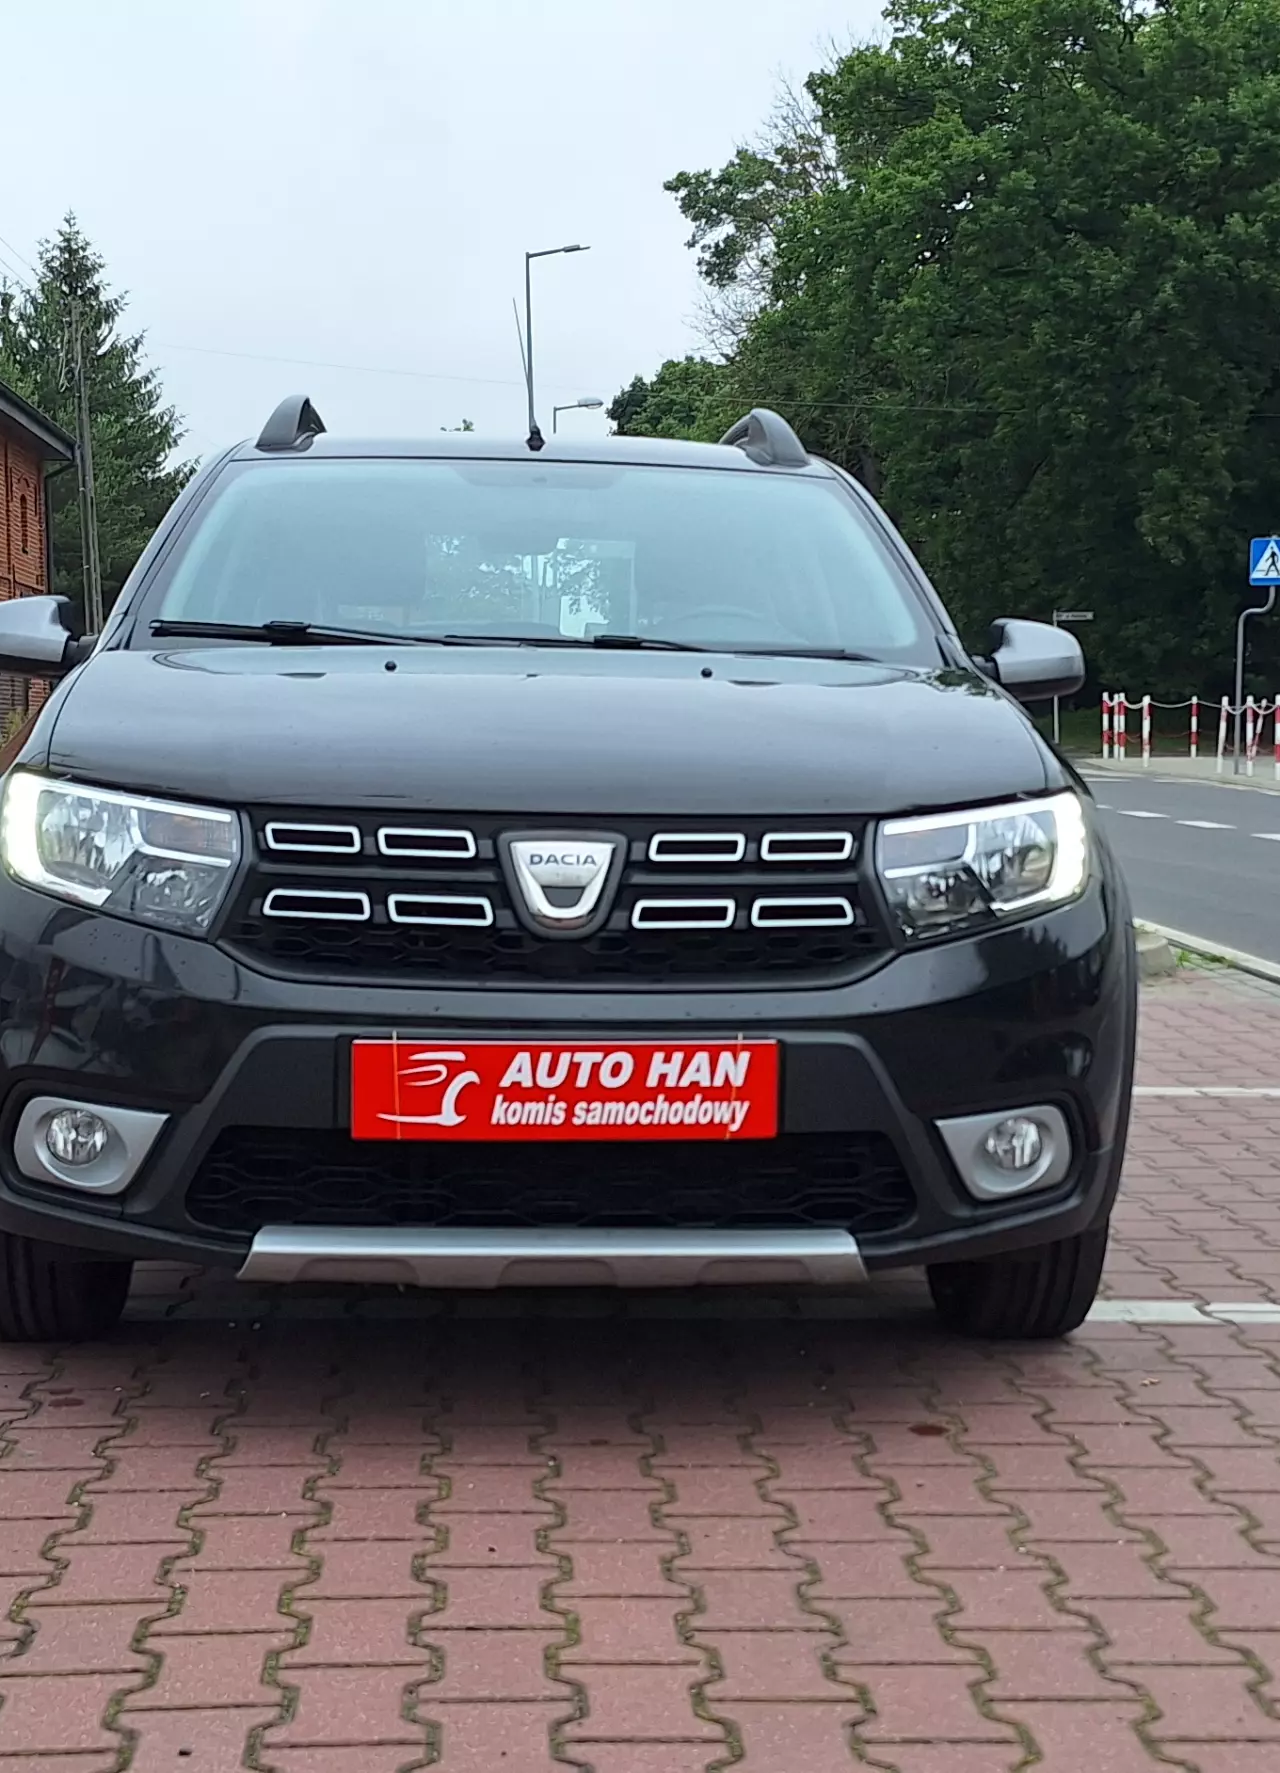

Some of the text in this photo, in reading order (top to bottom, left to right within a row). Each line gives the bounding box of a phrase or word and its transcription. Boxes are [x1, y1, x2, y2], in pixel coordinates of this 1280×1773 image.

[528, 853, 597, 866] DACIA
[498, 1050, 752, 1089] AUTO HAN
[490, 1093, 751, 1132] komis samochodowy
